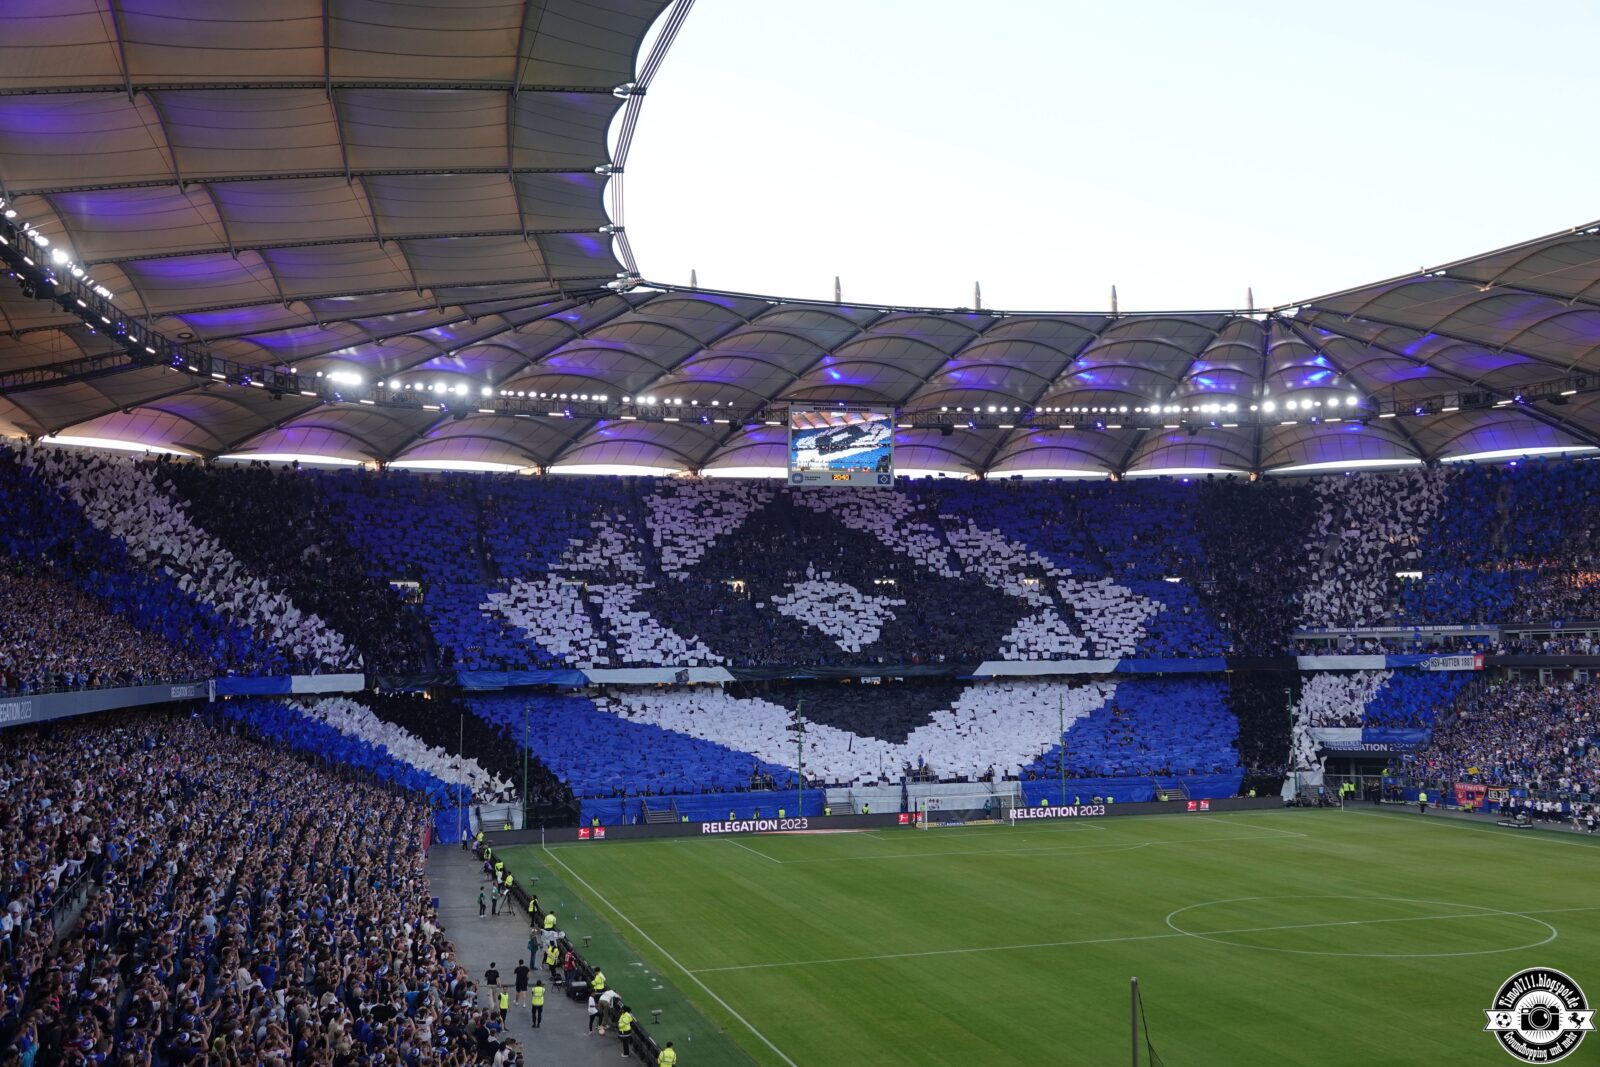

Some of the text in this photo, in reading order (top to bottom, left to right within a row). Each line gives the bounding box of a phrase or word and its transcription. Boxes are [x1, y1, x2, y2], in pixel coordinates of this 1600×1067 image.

[1010, 805, 1105, 819] RELEGATION 2023
[702, 818, 808, 834] RELEGATION 2023
